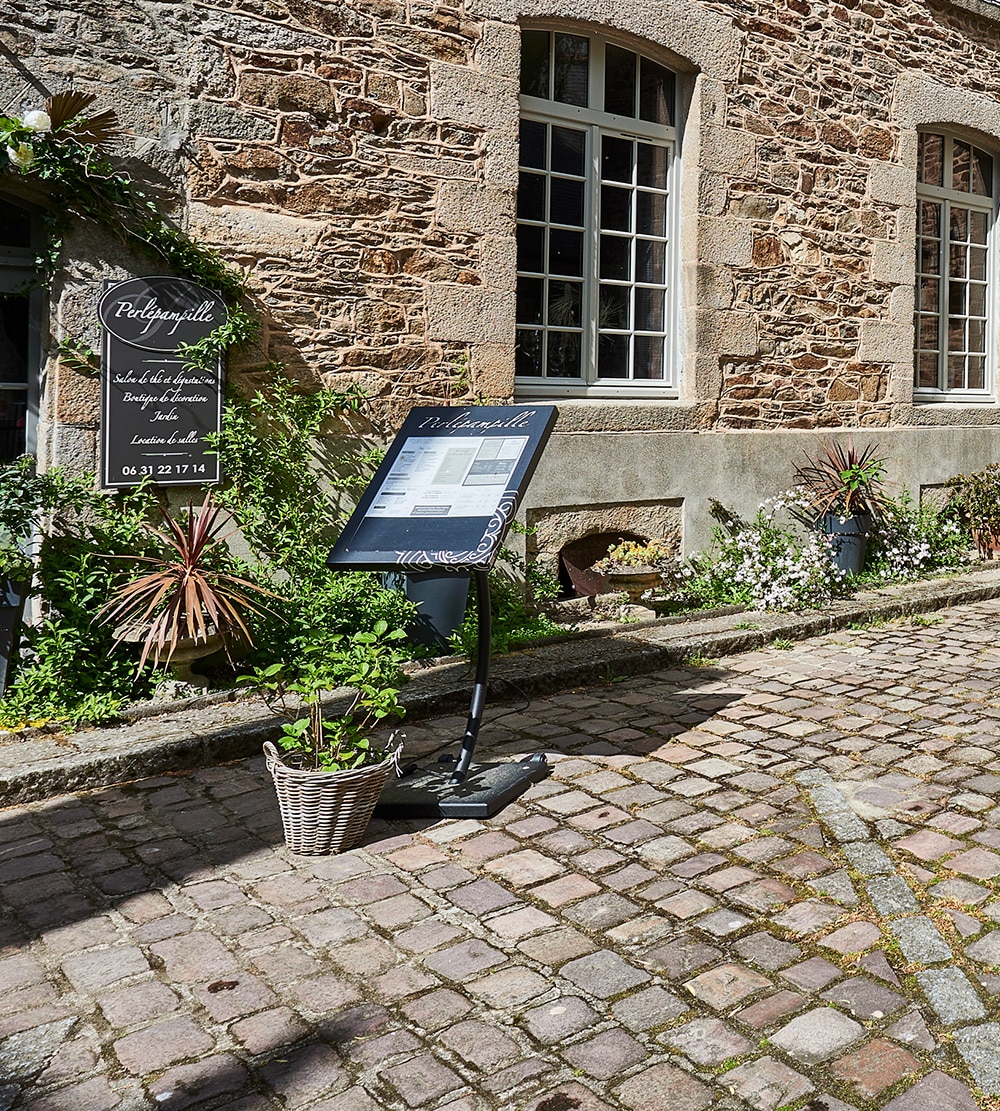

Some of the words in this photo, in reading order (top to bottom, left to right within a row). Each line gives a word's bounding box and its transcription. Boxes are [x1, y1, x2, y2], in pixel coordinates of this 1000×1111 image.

[115, 297, 215, 335] Perlépampille
[113, 370, 137, 383] Salon
[138, 370, 151, 384] de
[150, 369, 165, 384] thé
[164, 375, 172, 384] et
[122, 392, 159, 410] Boutique
[159, 388, 173, 402] de
[170, 389, 208, 402] décoration
[149, 407, 179, 422] Jardin
[130, 434, 166, 445] Location
[167, 430, 179, 445] de
[177, 430, 199, 444] salles
[122, 466, 137, 476] 06
[140, 465, 153, 475] 31
[157, 465, 172, 474] 22
[175, 464, 189, 474] 17
[192, 463, 206, 473] 14
